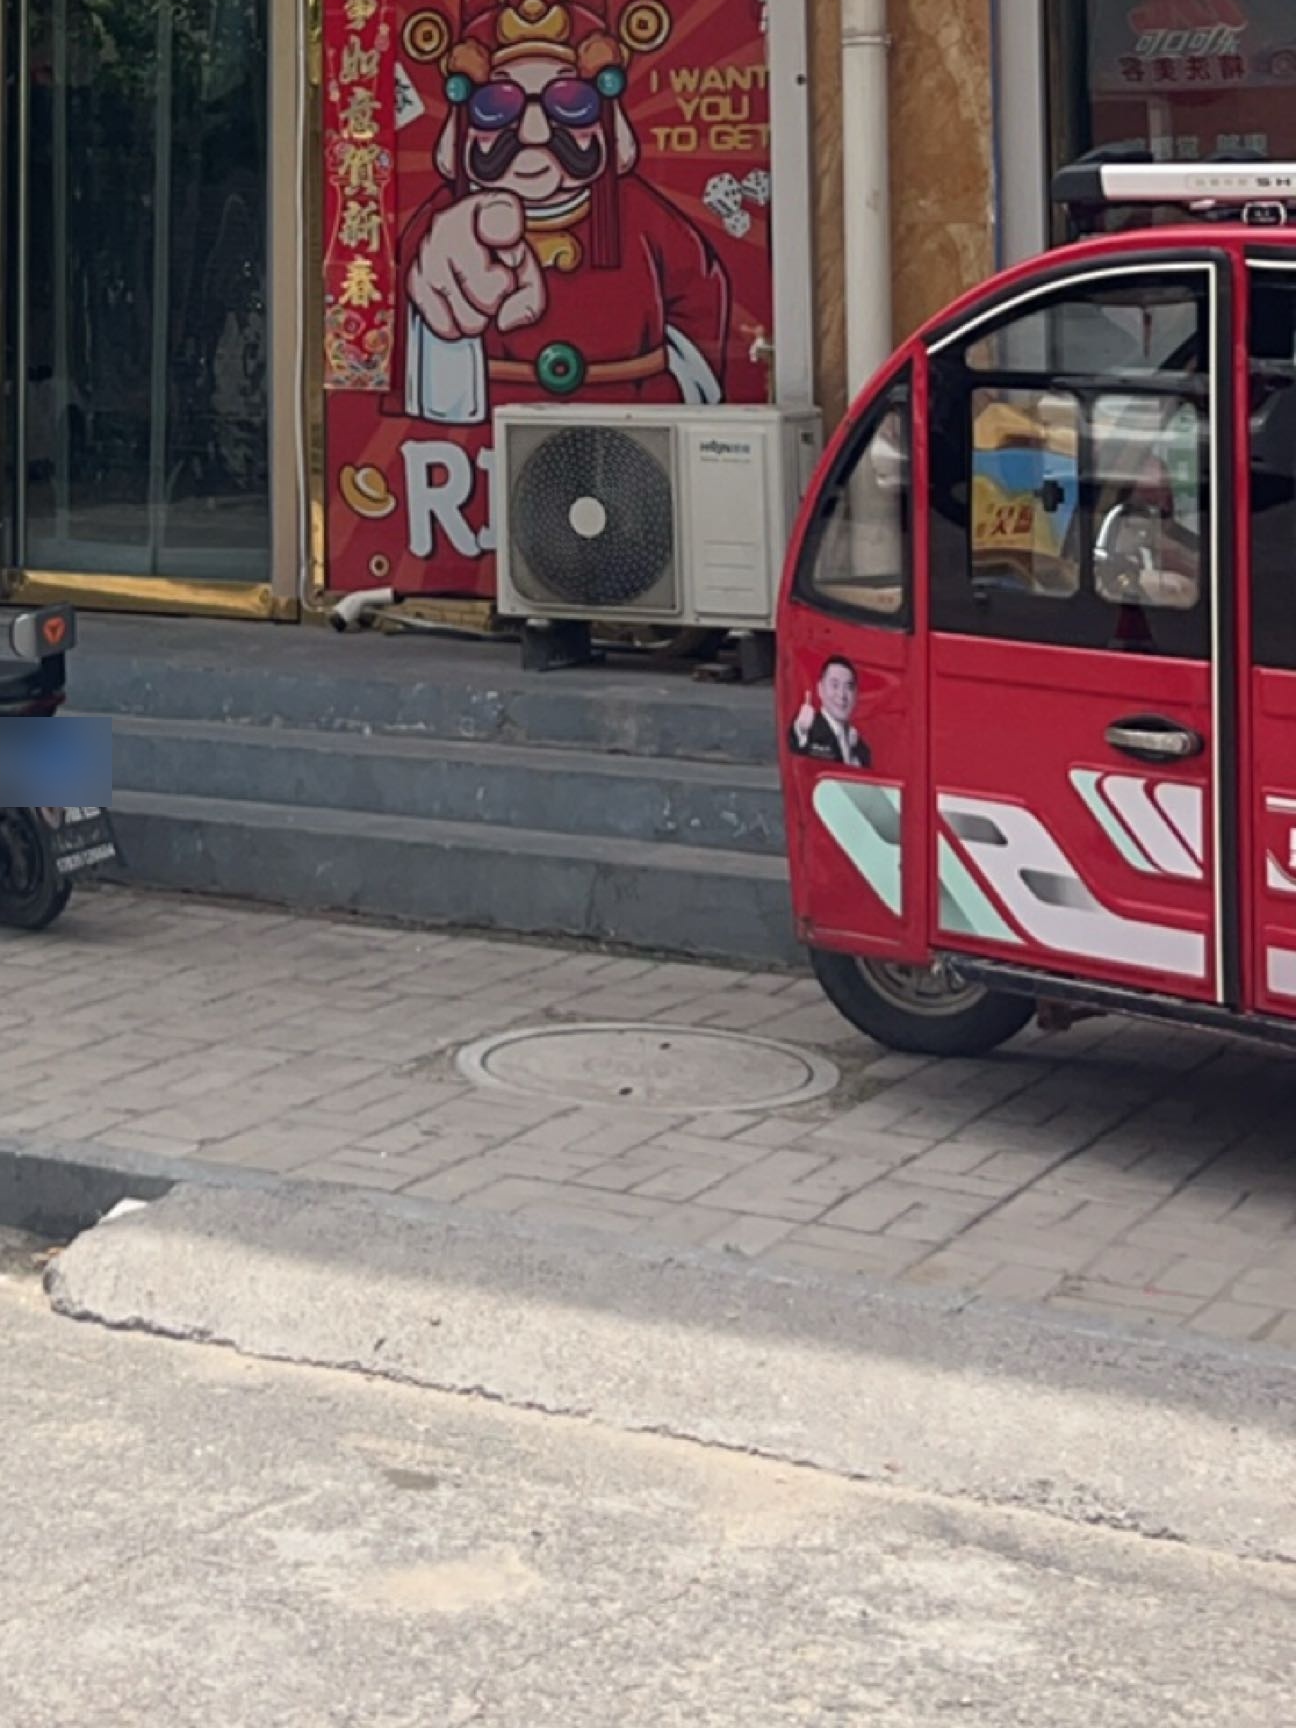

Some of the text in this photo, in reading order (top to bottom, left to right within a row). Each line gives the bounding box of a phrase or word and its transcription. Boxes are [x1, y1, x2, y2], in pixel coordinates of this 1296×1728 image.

[649, 64, 766, 93] I WANT
[675, 95, 749, 122] YOU
[649, 122, 770, 152] TO GET
